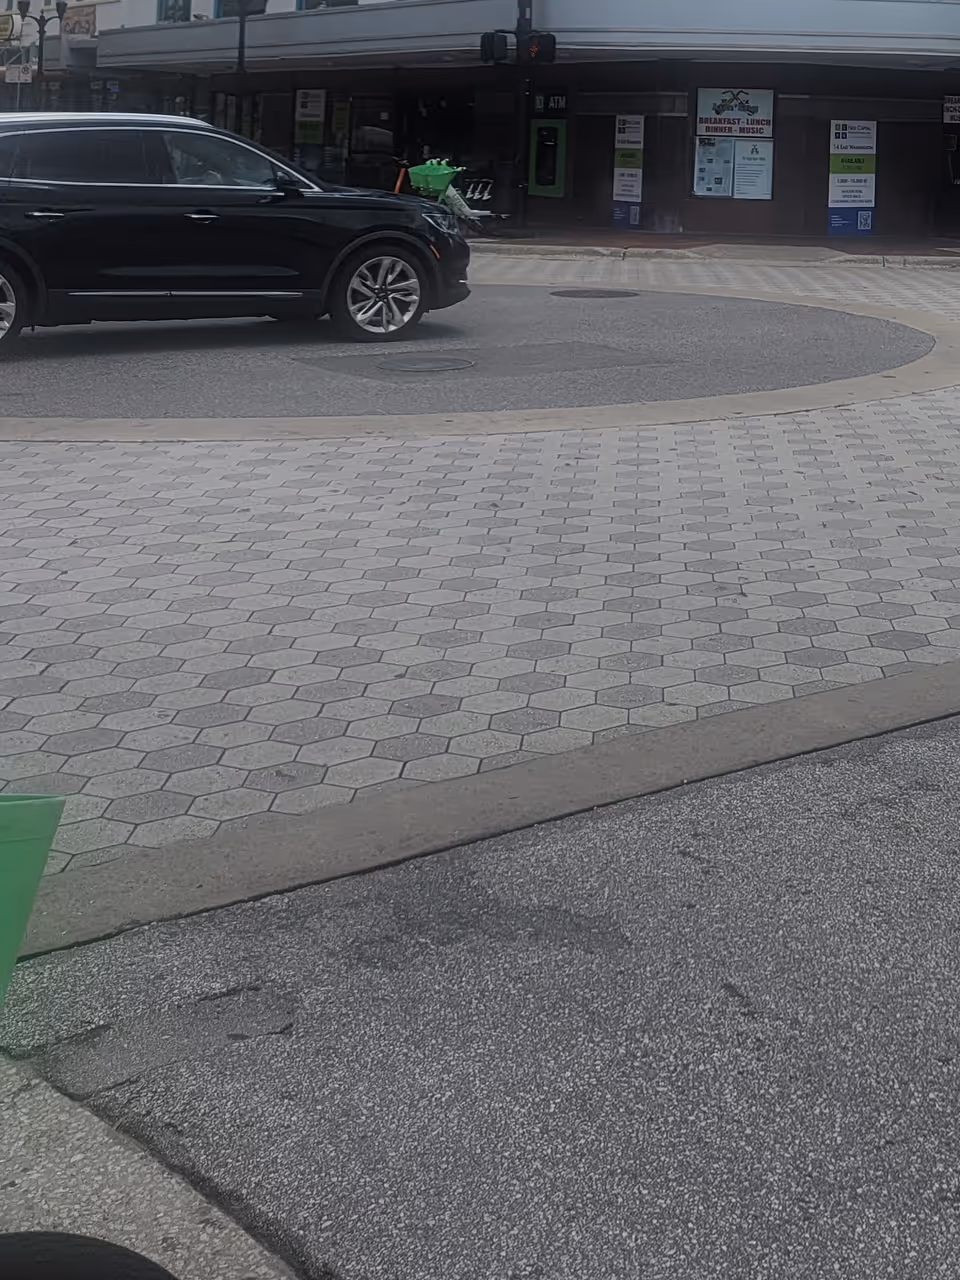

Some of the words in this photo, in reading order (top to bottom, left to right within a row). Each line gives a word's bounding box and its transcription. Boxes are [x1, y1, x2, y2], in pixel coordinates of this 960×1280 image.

[548, 96, 566, 108] ATM
[699, 117, 741, 125] BREAKFAST
[746, 118, 771, 126] LUNCH
